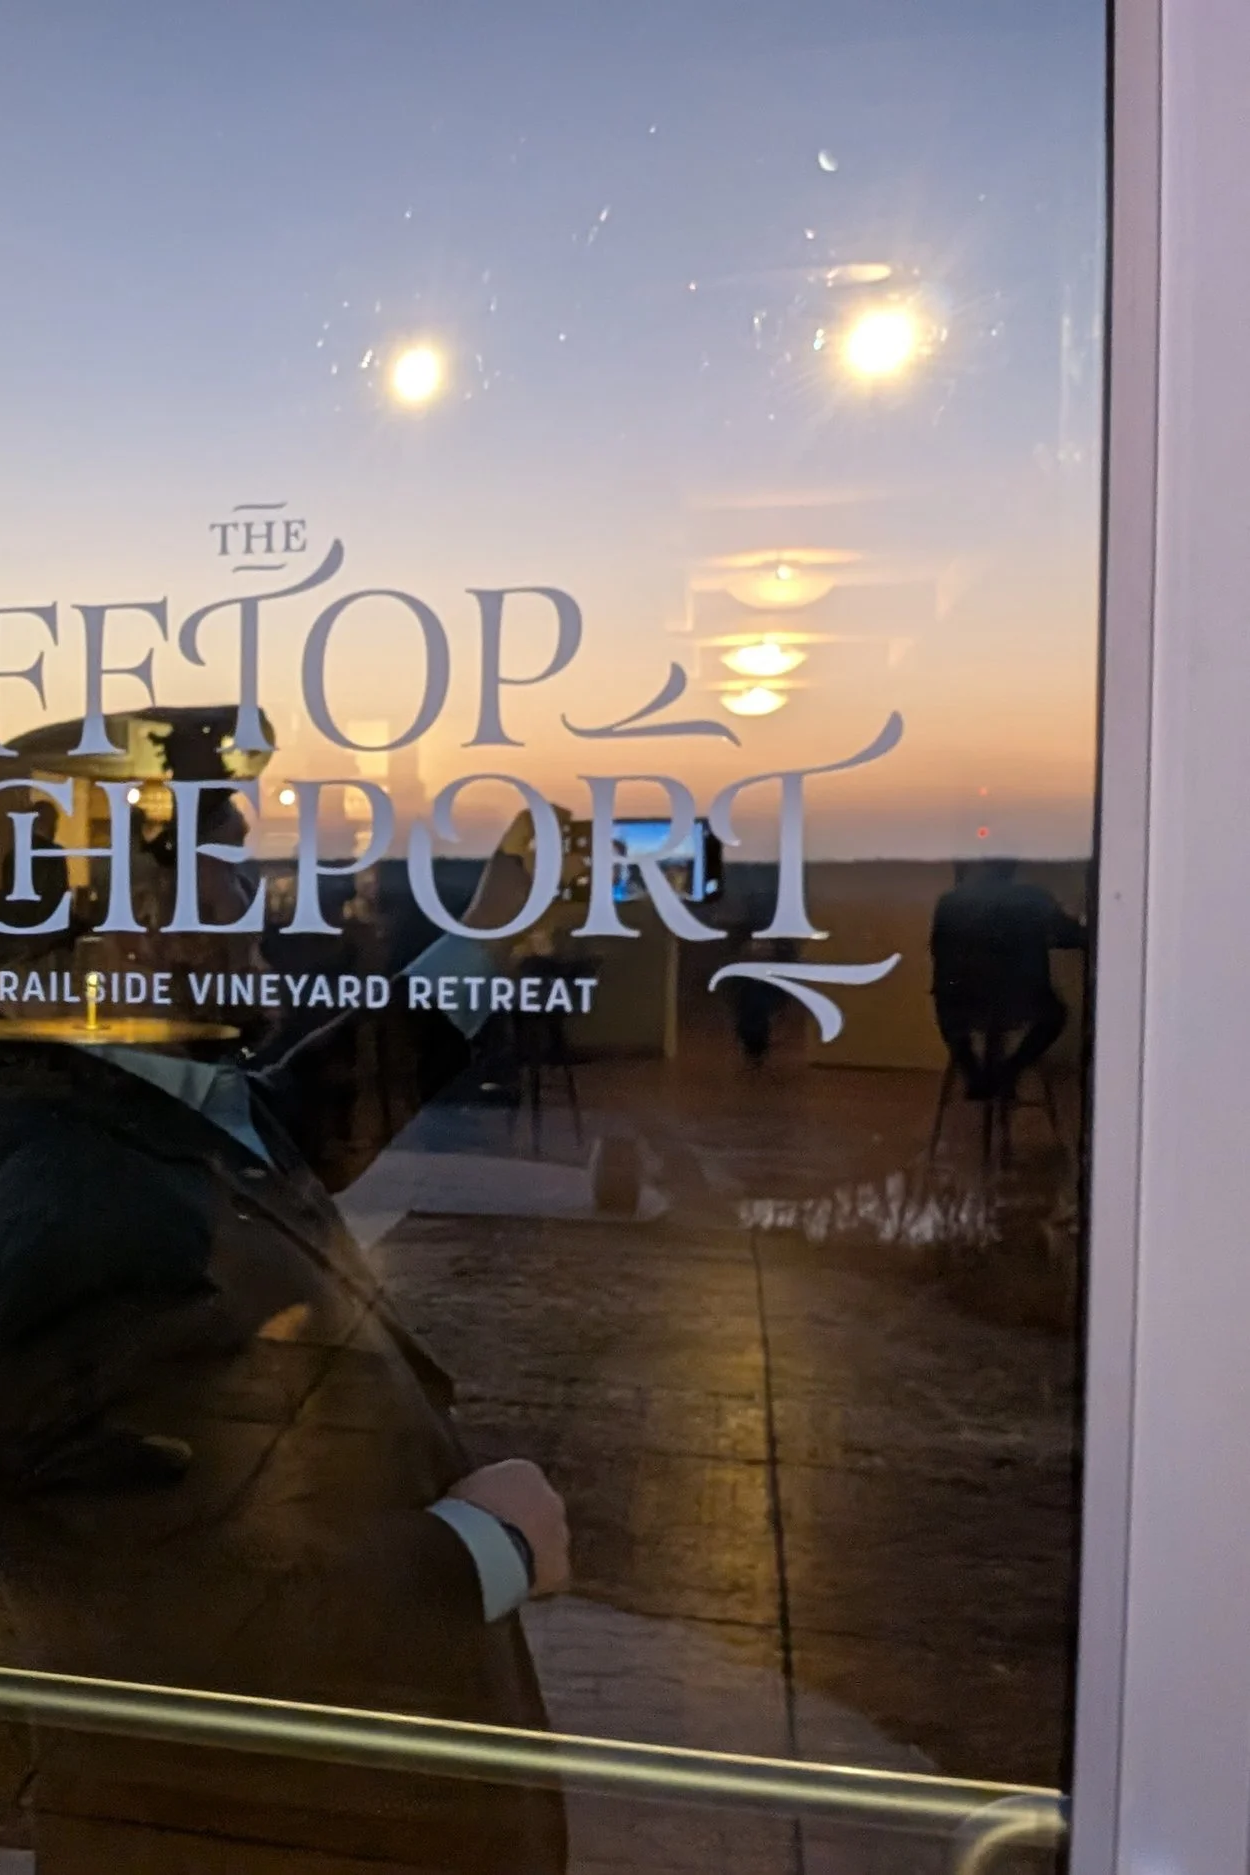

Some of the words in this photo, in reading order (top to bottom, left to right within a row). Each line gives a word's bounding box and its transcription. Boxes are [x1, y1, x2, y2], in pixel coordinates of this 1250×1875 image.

[209, 519, 307, 556] THE
[188, 972, 390, 1009] VINEYARD
[407, 975, 598, 1014] RETREAT
